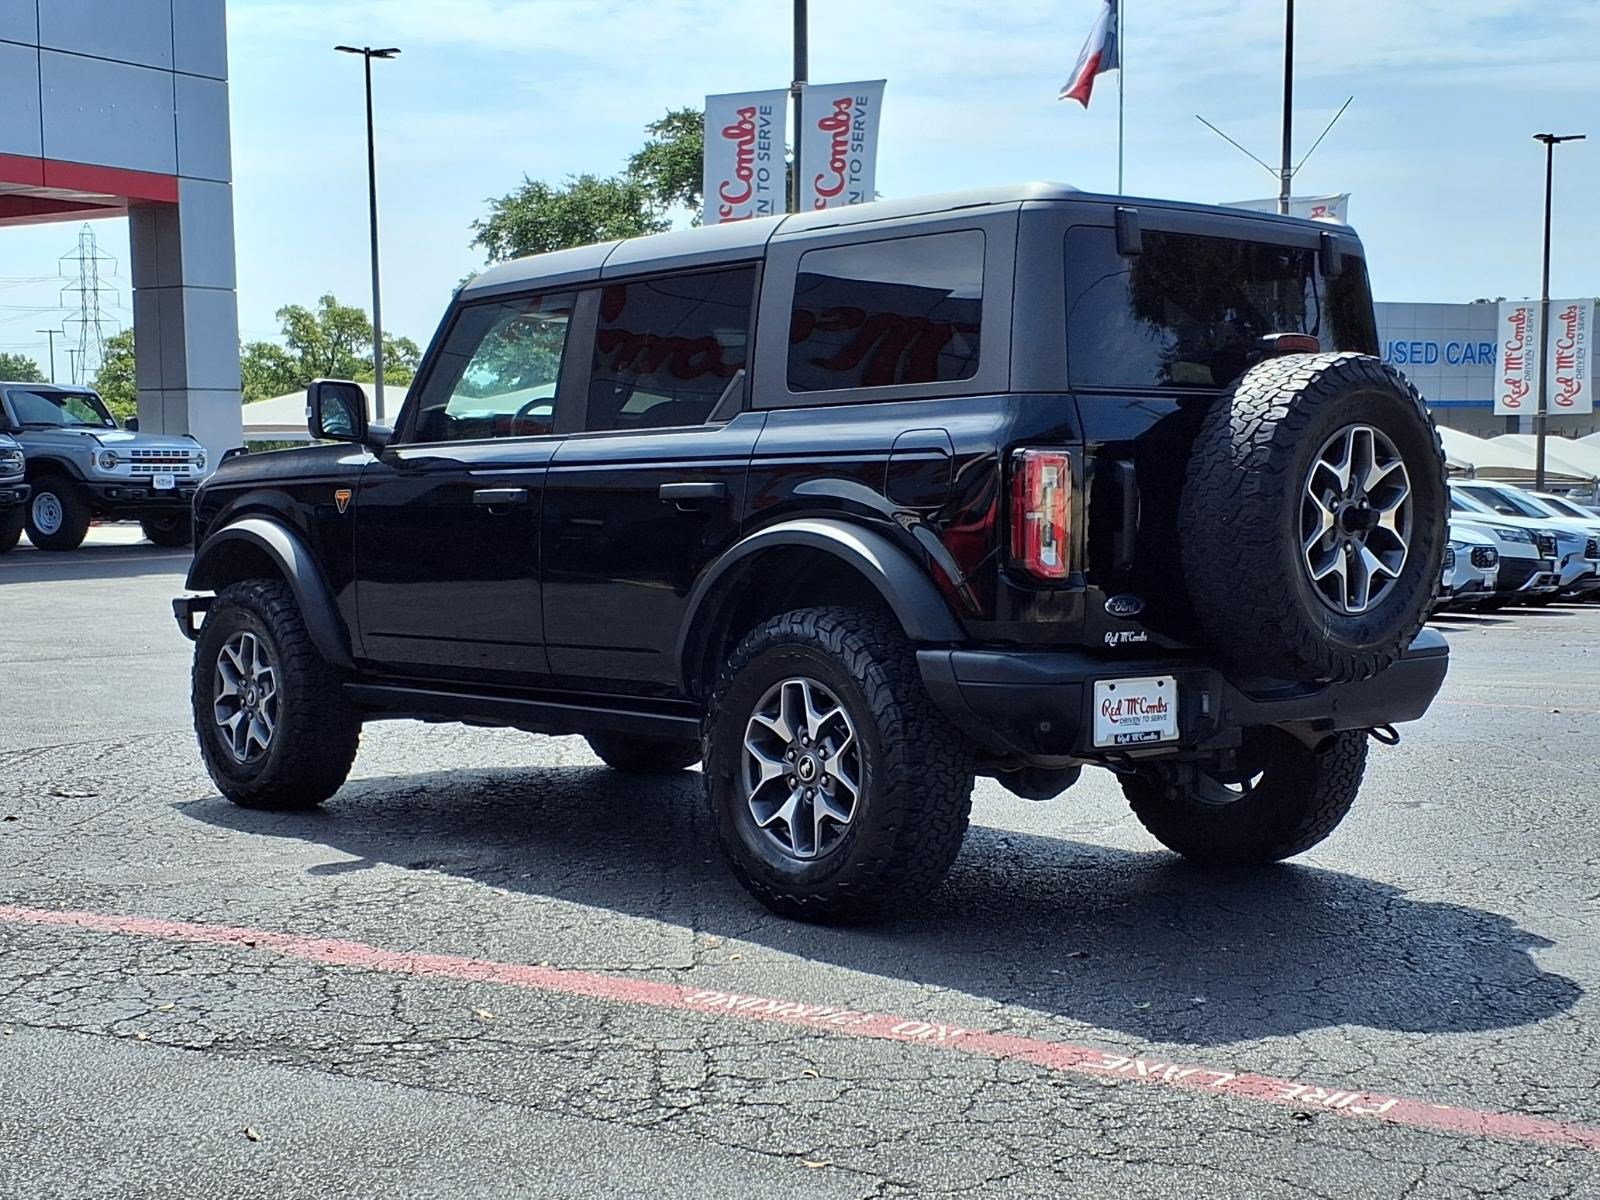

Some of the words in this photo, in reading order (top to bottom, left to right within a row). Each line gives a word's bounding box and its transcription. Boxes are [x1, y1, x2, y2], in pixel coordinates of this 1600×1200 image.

[758, 105, 772, 162] SERVE
[851, 95, 869, 152] SERVE
[757, 167, 770, 193] TO
[849, 158, 863, 184] TO
[1526, 307, 1534, 333] SERVE
[1578, 305, 1586, 331] SERVE
[1504, 307, 1526, 376] McCombs
[1525, 335, 1533, 347] TO
[1556, 305, 1577, 375] McCombs
[1577, 333, 1584, 345] TO
[1524, 349, 1533, 381] DRIVEN
[1576, 347, 1584, 380] DRIVEN
[1502, 378, 1529, 408] Red
[1554, 377, 1581, 407] Red
[1105, 631, 1119, 647] Red
[1120, 630, 1148, 643] McCombs
[1102, 698, 1123, 724] Red
[1124, 696, 1169, 716] McCombs
[1119, 716, 1141, 725] DRIVEN
[1142, 715, 1150, 723] TO
[1151, 713, 1168, 722] SERVE
[890, 1021, 967, 1040] NO
[1084, 1054, 1237, 1085] LANE
[1278, 1083, 1400, 1114] FIRE
